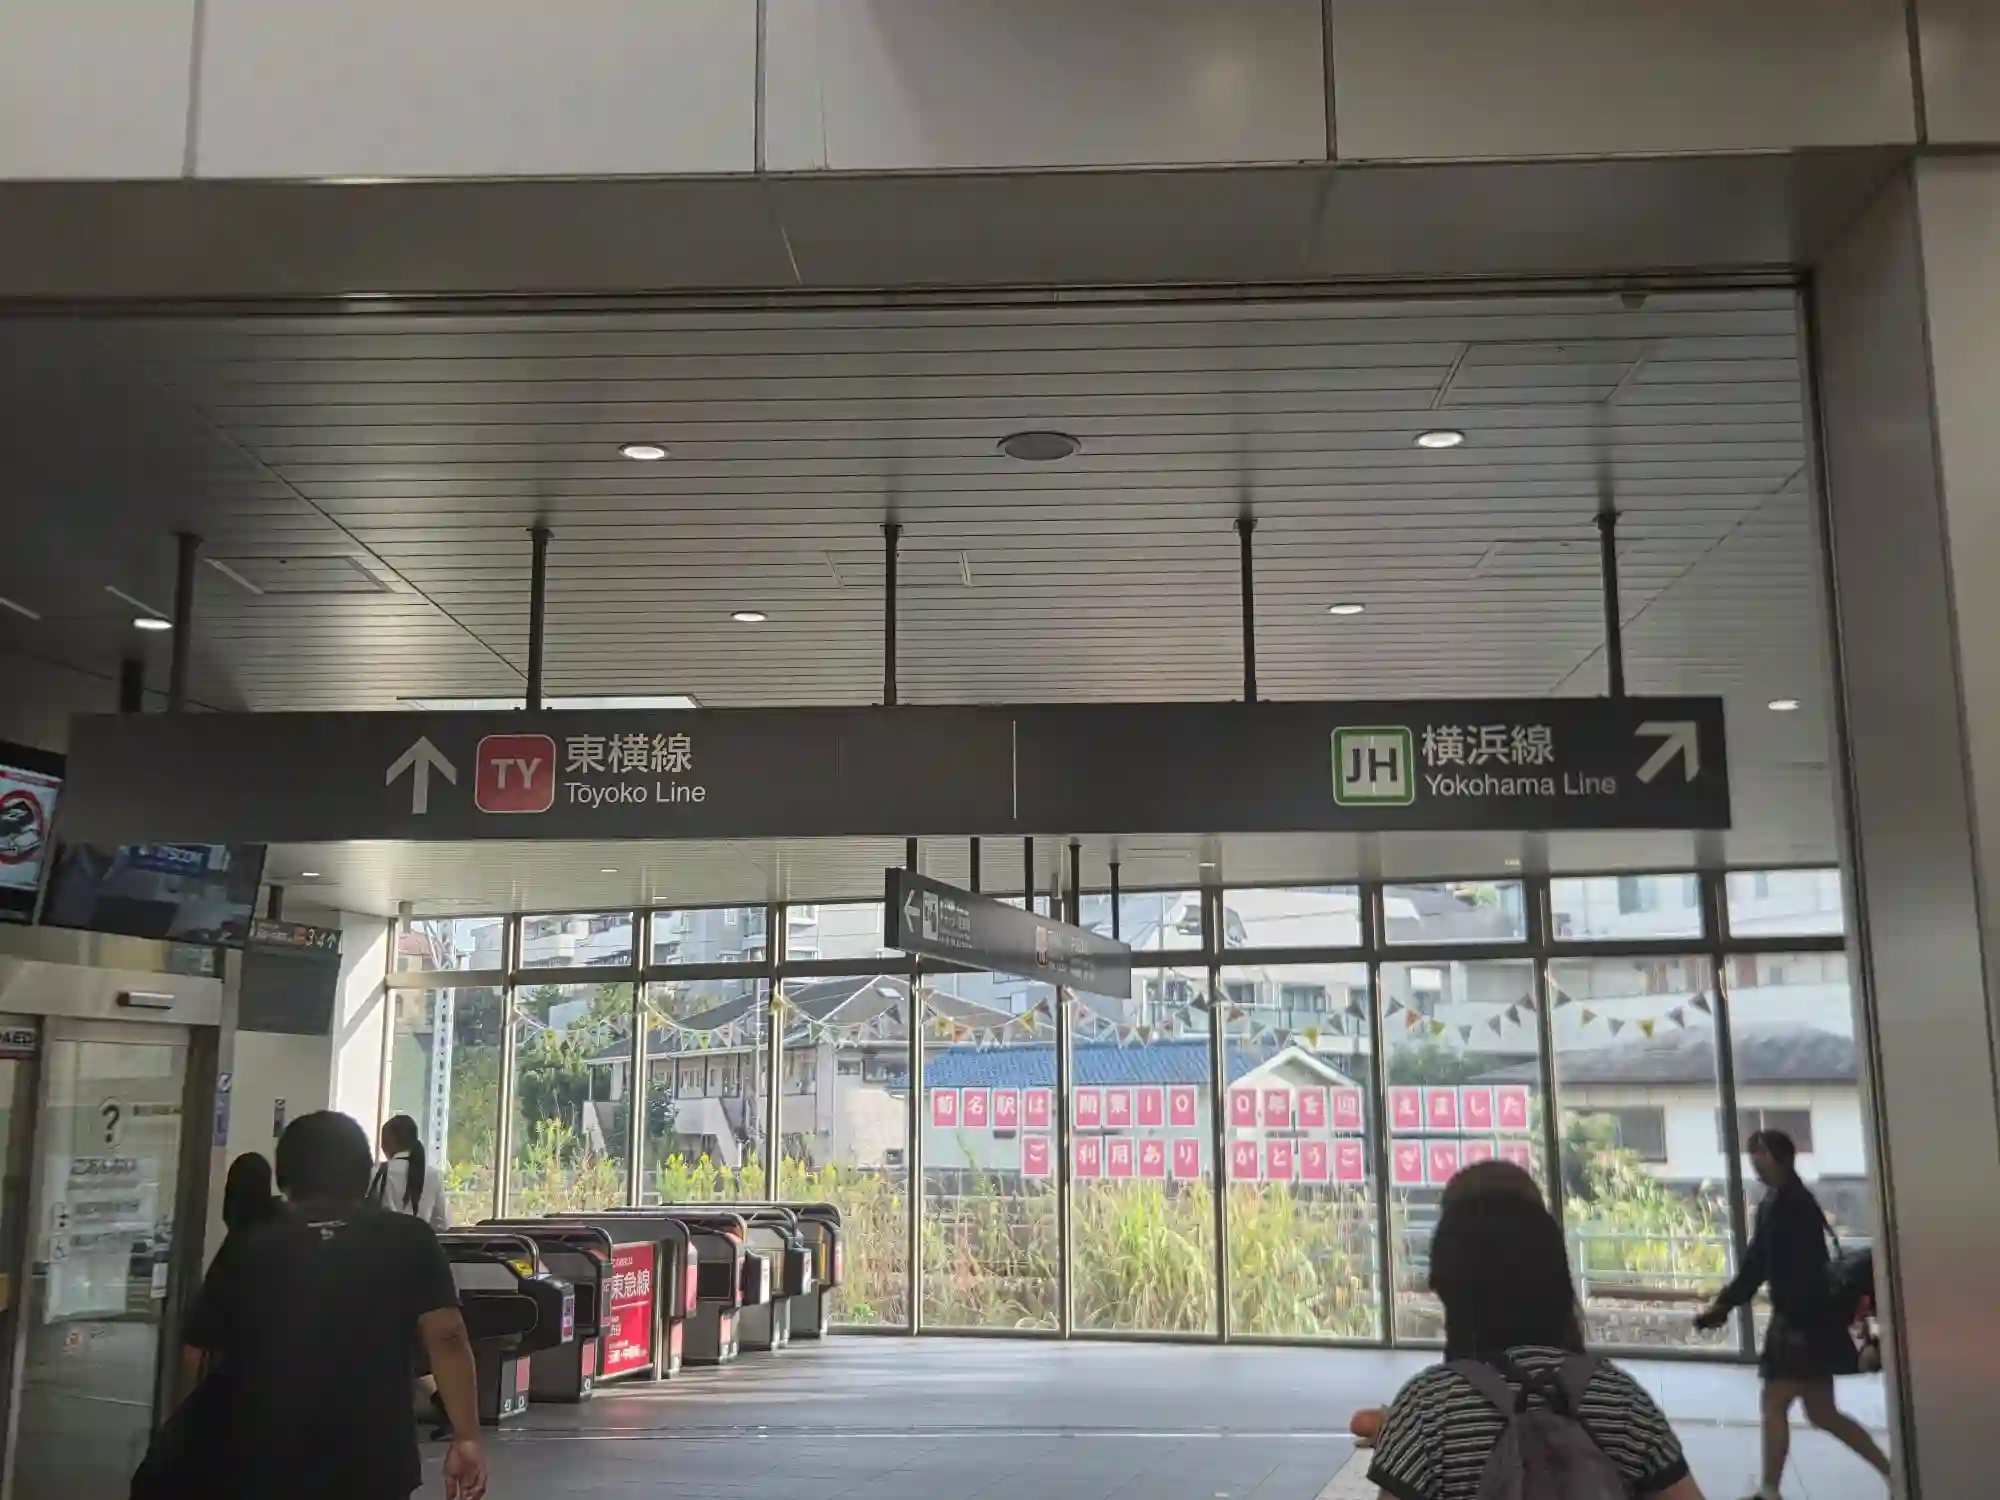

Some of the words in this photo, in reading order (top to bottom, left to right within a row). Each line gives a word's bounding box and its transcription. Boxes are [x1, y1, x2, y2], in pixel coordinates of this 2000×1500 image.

[565, 733, 693, 774] 東横線
[1422, 724, 1555, 766] 横浜線
[490, 757, 543, 790] TY
[1345, 746, 1399, 783] JH
[655, 782, 706, 804] Line
[1423, 773, 1556, 797] Yokohama
[1563, 771, 1617, 795] Line
[611, 1268, 650, 1300] 東急線
